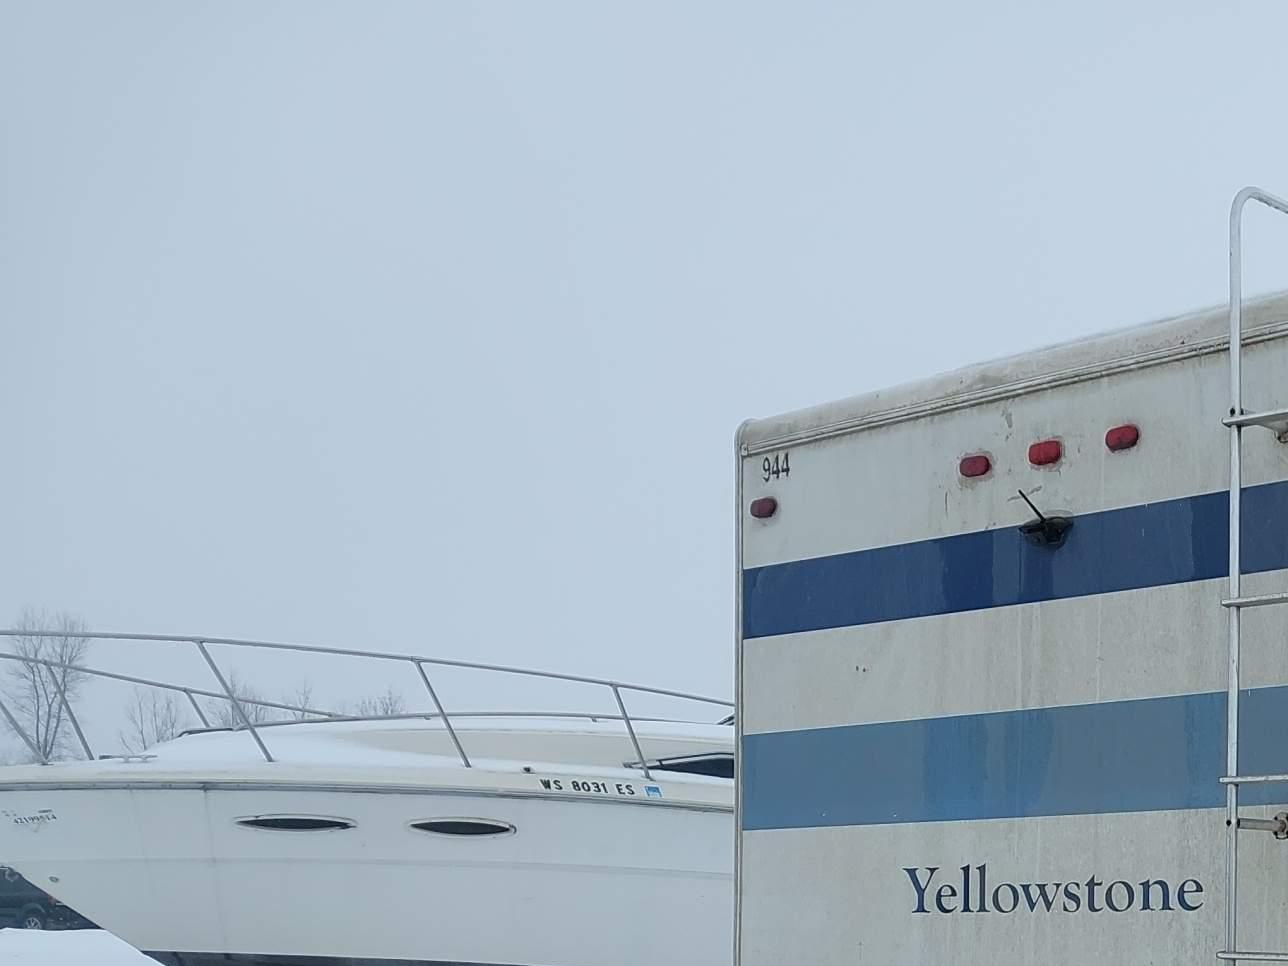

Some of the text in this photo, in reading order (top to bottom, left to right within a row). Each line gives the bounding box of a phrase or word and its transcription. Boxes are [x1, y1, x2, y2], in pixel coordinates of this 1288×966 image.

[762, 452, 790, 482] 944
[540, 778, 635, 795] WS 8031 ES
[902, 862, 1205, 914] Yellowstone
